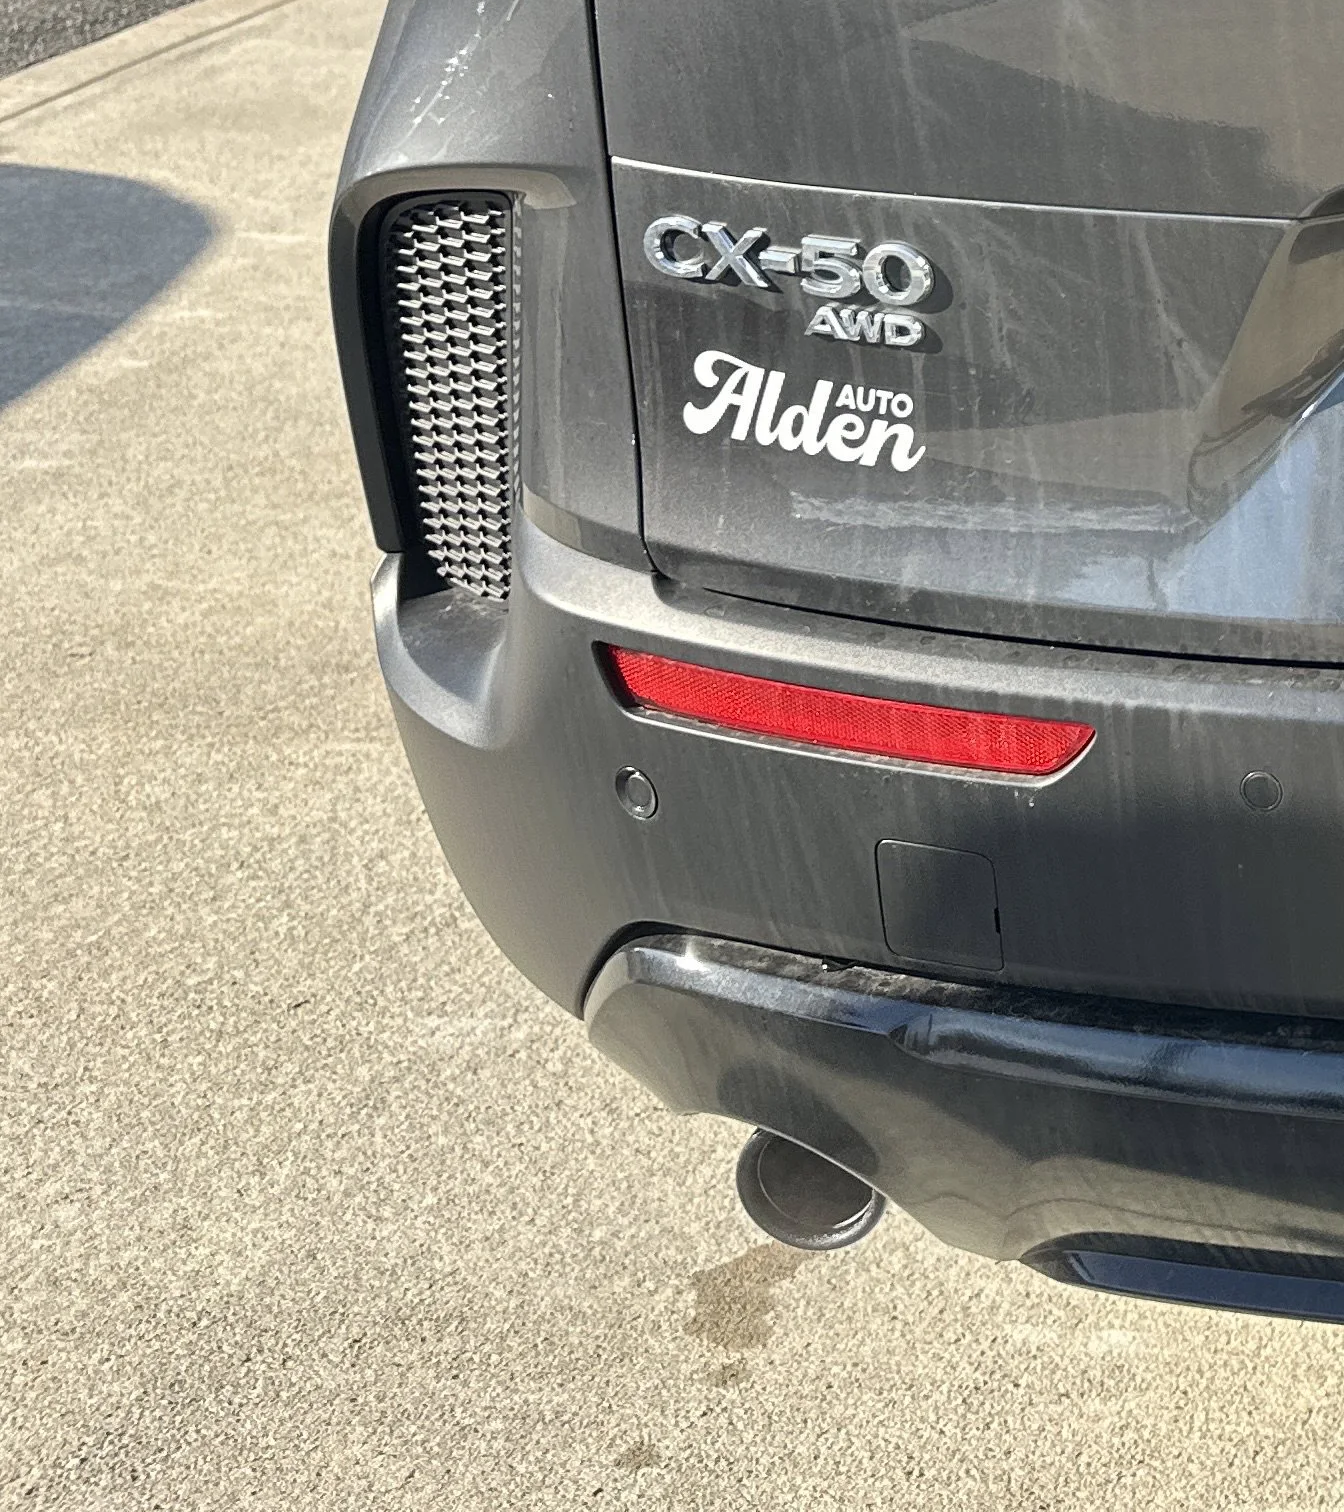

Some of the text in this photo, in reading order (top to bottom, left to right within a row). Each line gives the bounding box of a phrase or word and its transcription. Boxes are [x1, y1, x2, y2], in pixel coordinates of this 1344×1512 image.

[643, 214, 935, 306] CX-50
[804, 303, 926, 346] AWD
[683, 350, 926, 472] Alden
[836, 384, 914, 419] AUTO
